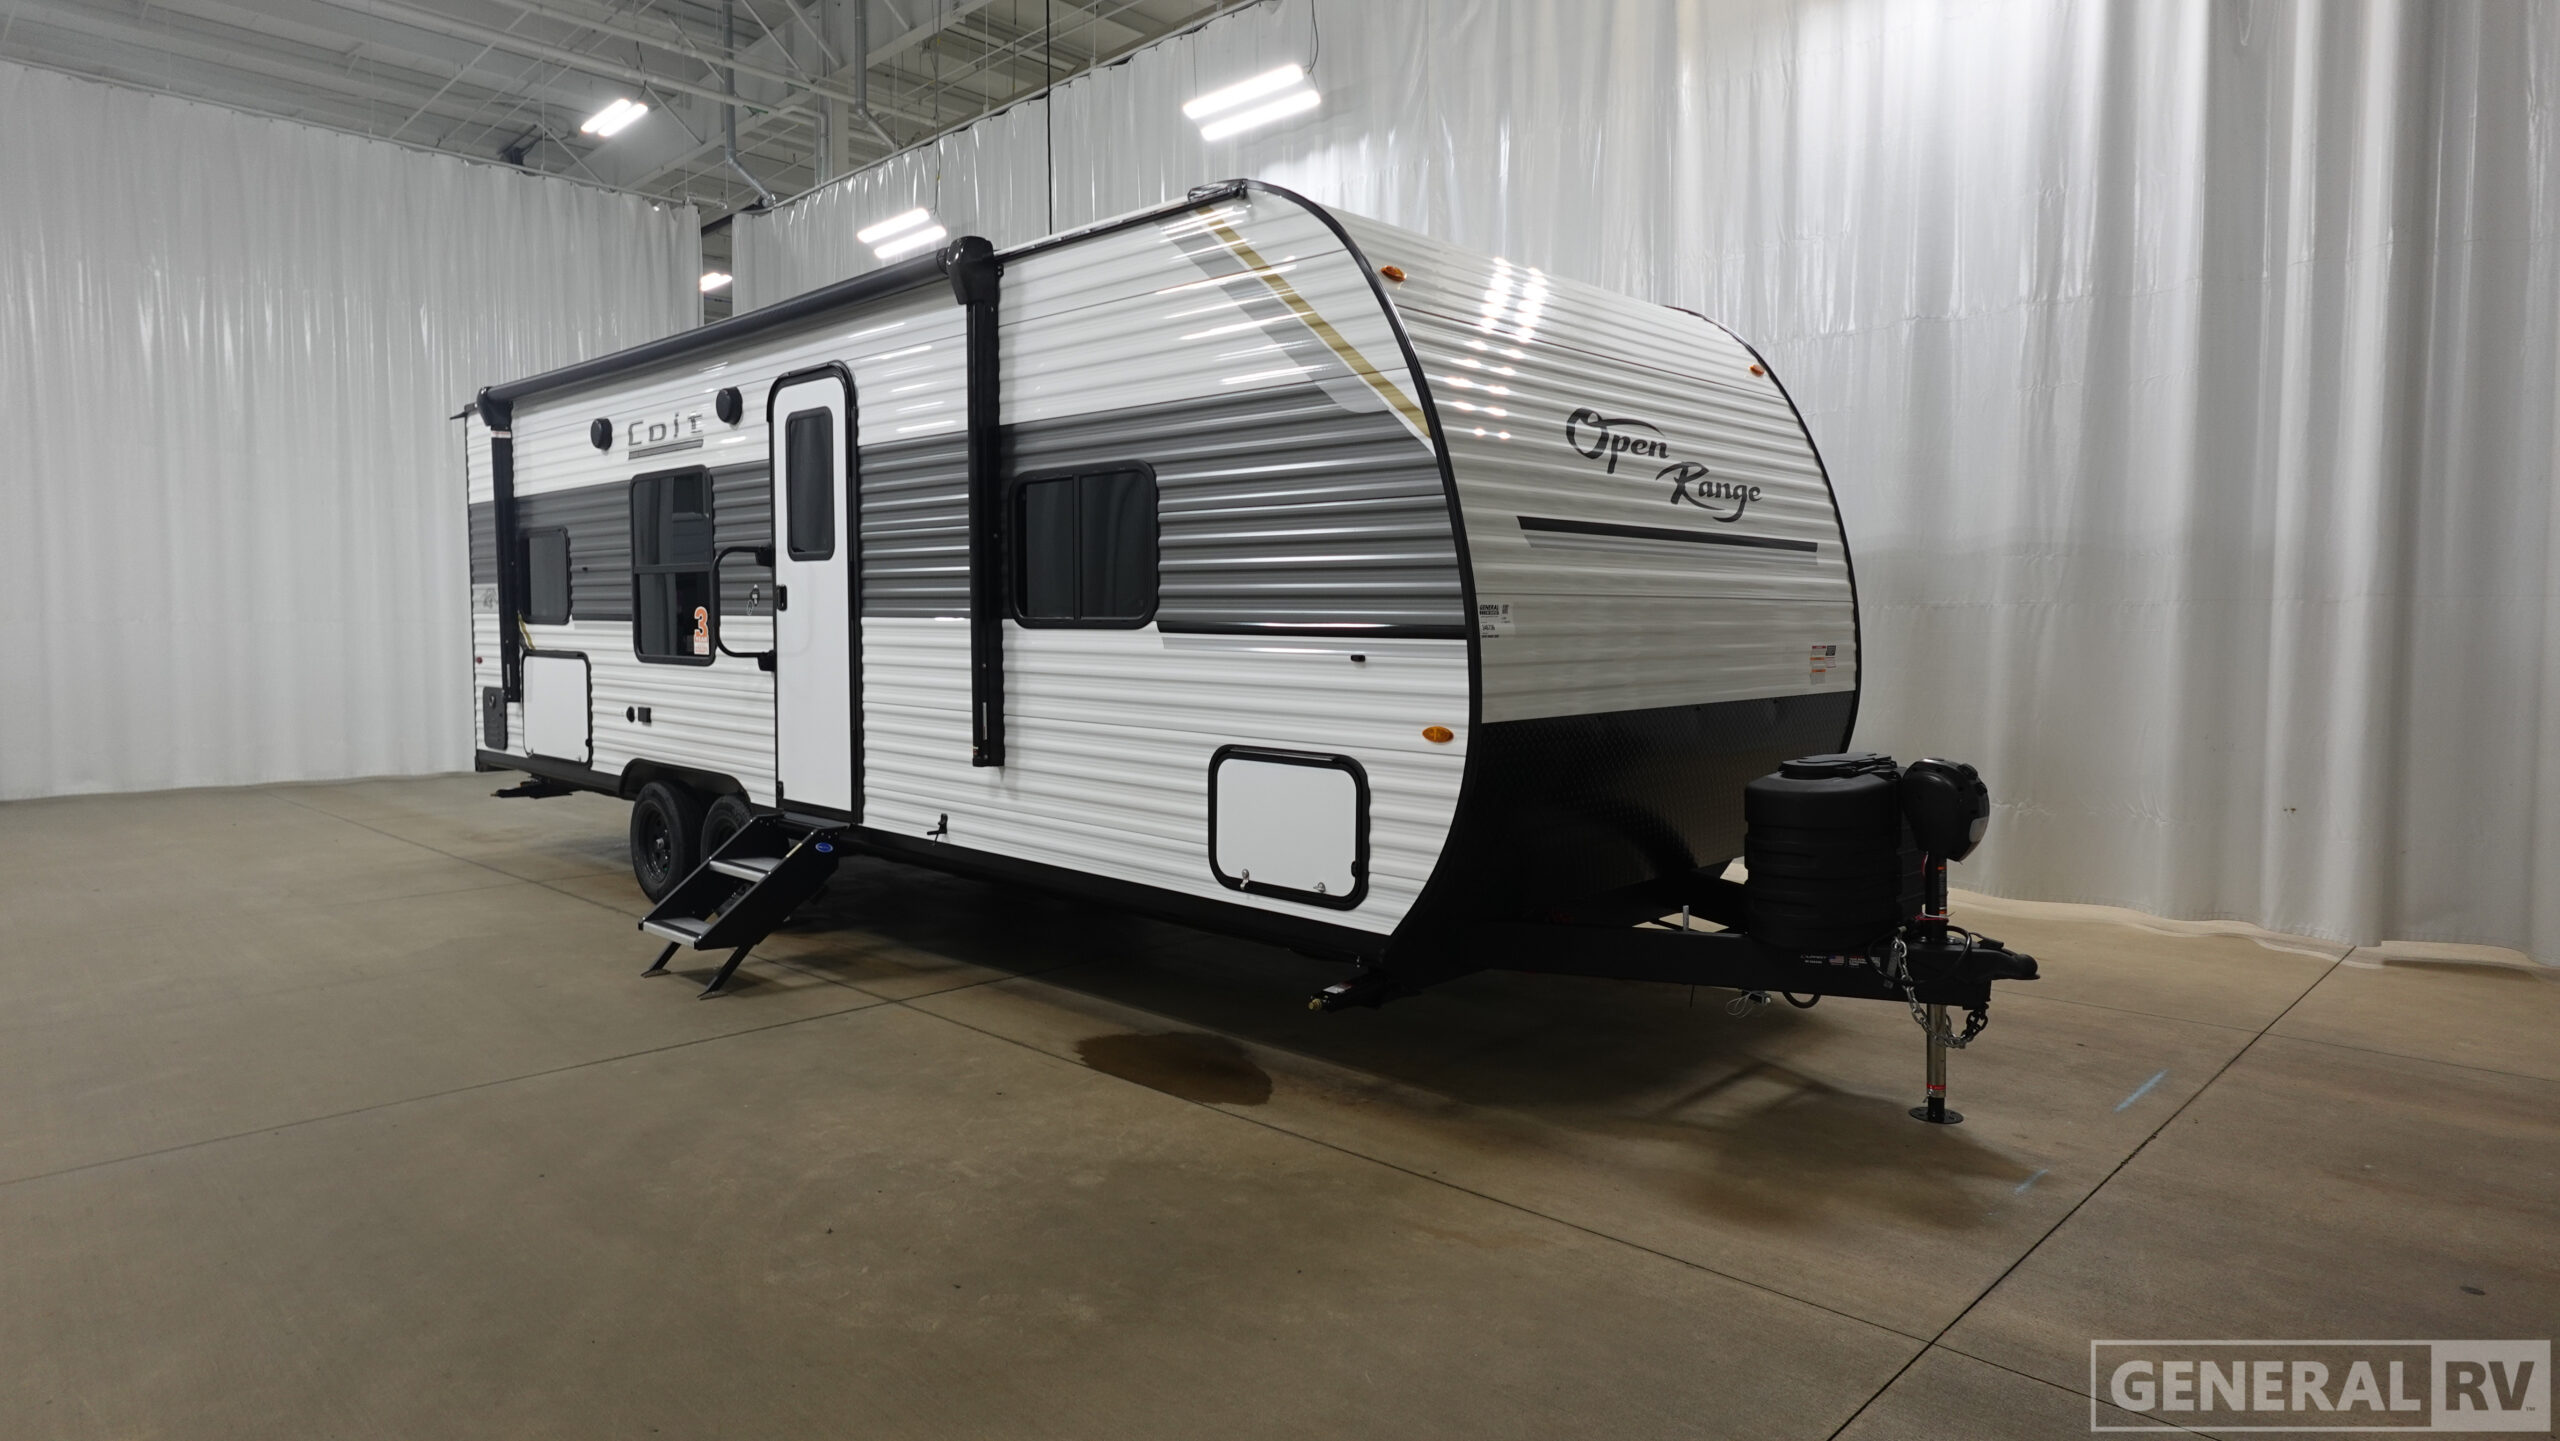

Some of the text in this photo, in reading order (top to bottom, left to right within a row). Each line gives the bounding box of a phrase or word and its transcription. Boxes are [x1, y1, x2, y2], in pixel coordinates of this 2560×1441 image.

[1566, 407, 1669, 474] Open
[1656, 461, 1763, 523] Range
[694, 606, 708, 638] 3
